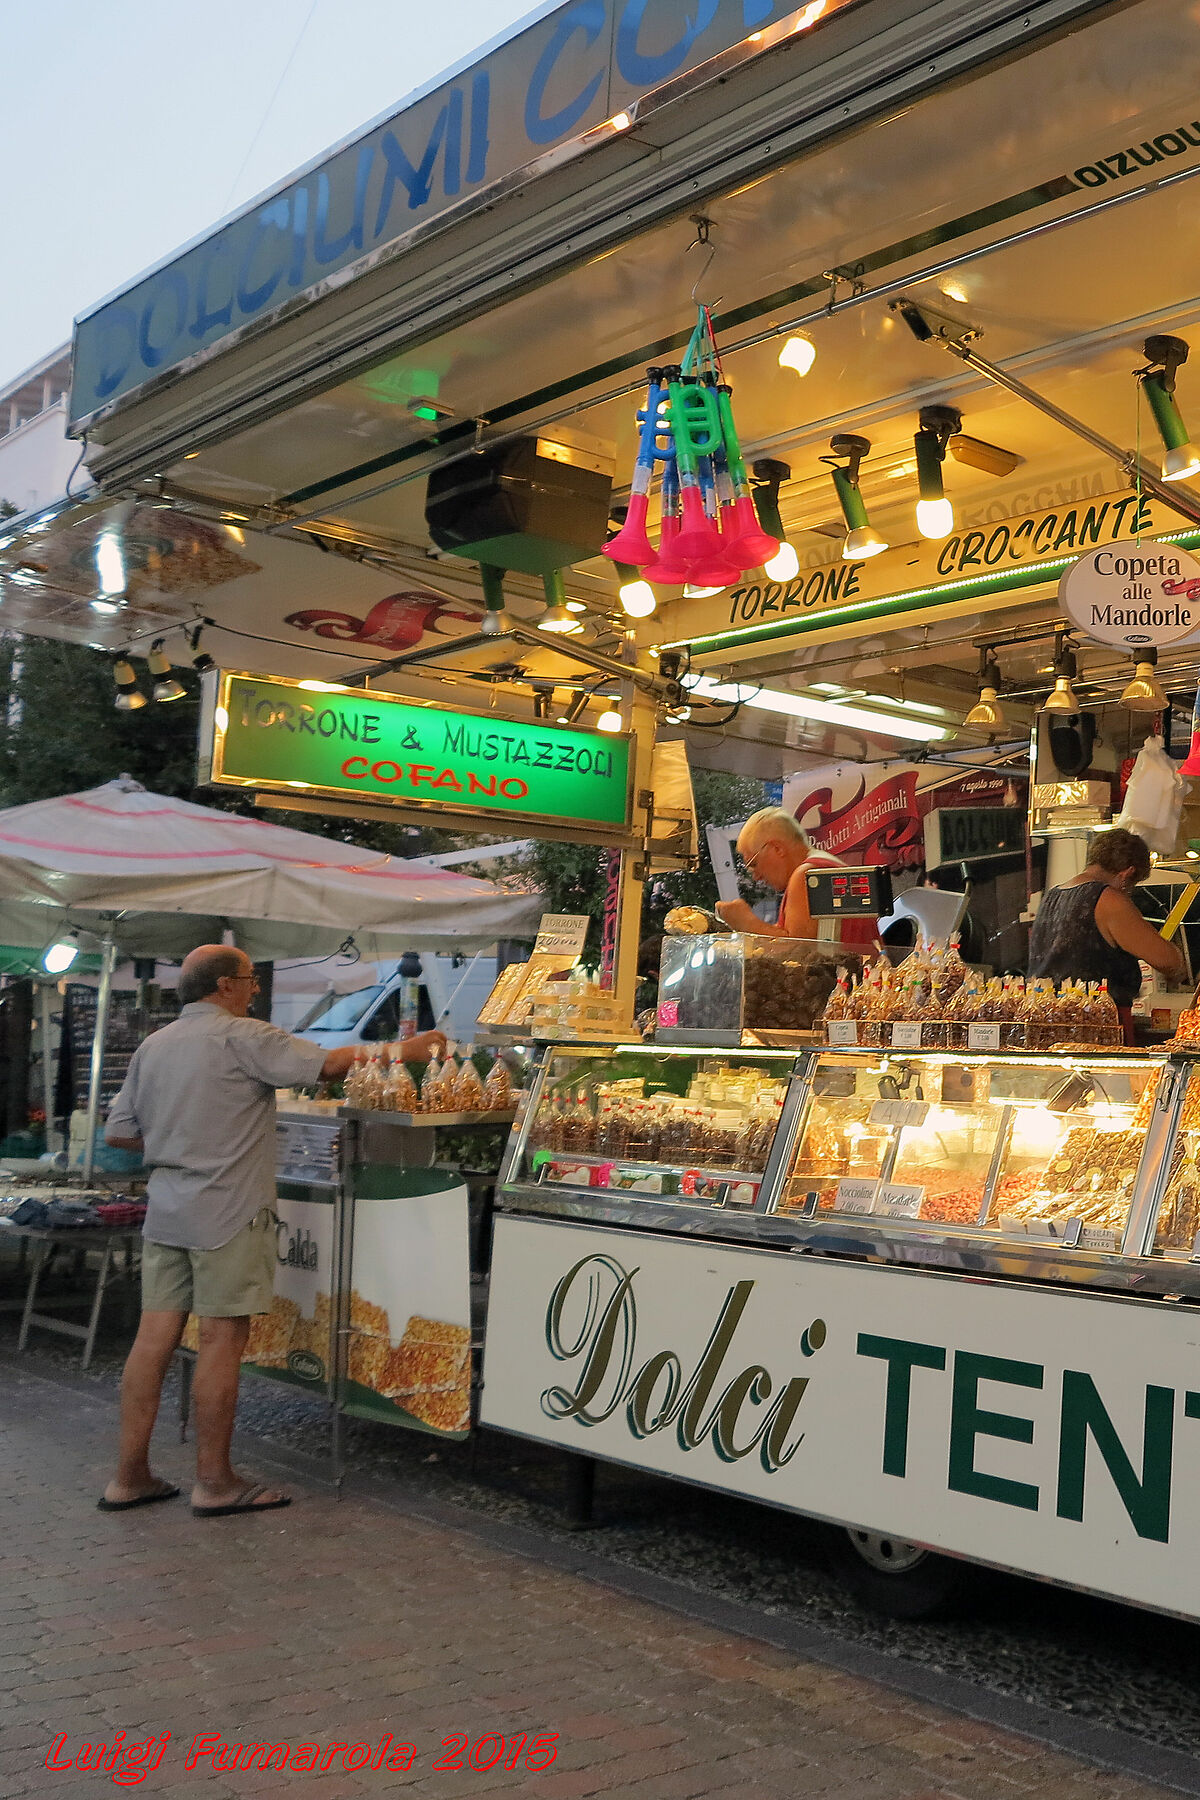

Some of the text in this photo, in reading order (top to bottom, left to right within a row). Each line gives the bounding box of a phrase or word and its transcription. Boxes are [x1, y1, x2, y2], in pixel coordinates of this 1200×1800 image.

[92, 0, 774, 400] DOLCIUMI CO
[728, 562, 867, 625] TORRONE
[936, 494, 1155, 576] CROCCANTE
[1094, 552, 1182, 581] Copeta
[1090, 603, 1192, 627] Mandorle
[1122, 583, 1152, 600] alle
[238, 688, 381, 744] TORRONE
[340, 755, 529, 800] COFANO
[808, 789, 907, 853] Prodotti Artigianali
[277, 1220, 319, 1272] Calda
[540, 1252, 827, 1475] Dolci
